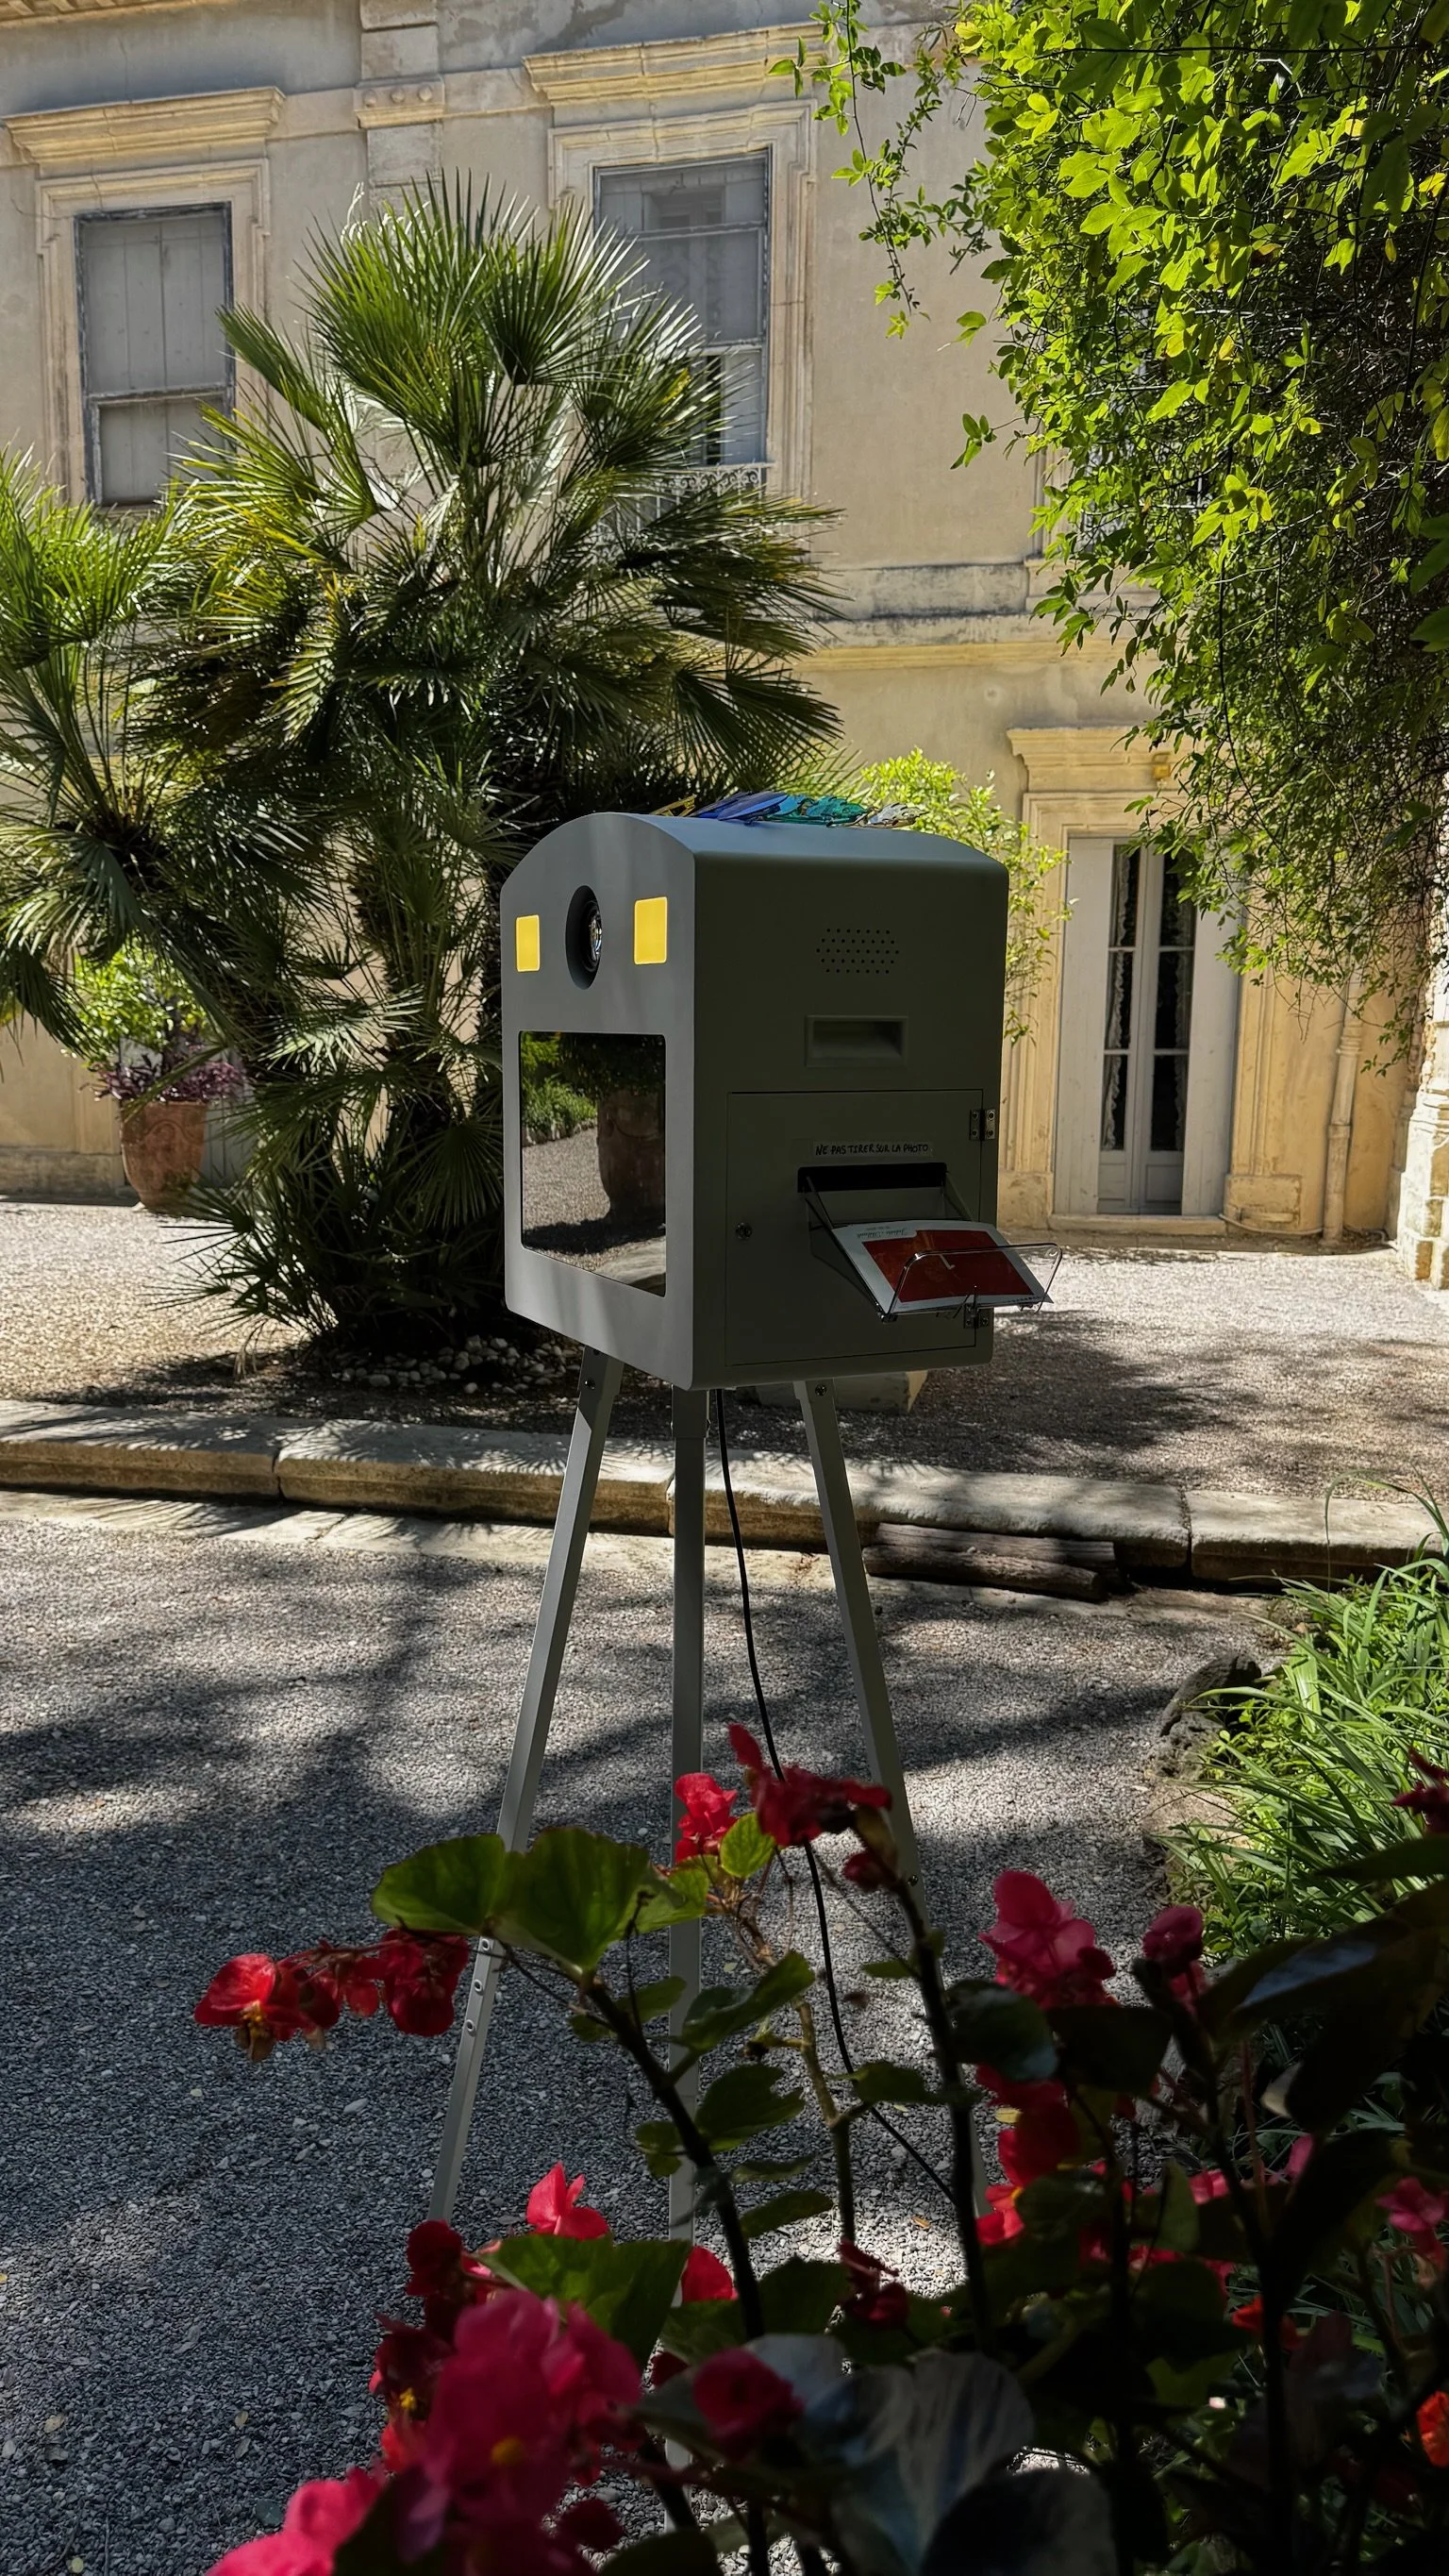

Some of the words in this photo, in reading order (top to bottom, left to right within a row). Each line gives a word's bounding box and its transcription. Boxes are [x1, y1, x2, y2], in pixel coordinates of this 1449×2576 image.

[815, 1144, 829, 1155] NE
[830, 1145, 846, 1154] PAS
[848, 1144, 875, 1153] TIRER
[875, 1144, 890, 1152] SUR
[891, 1144, 902, 1152] LA
[903, 1143, 928, 1152] PHOTO
